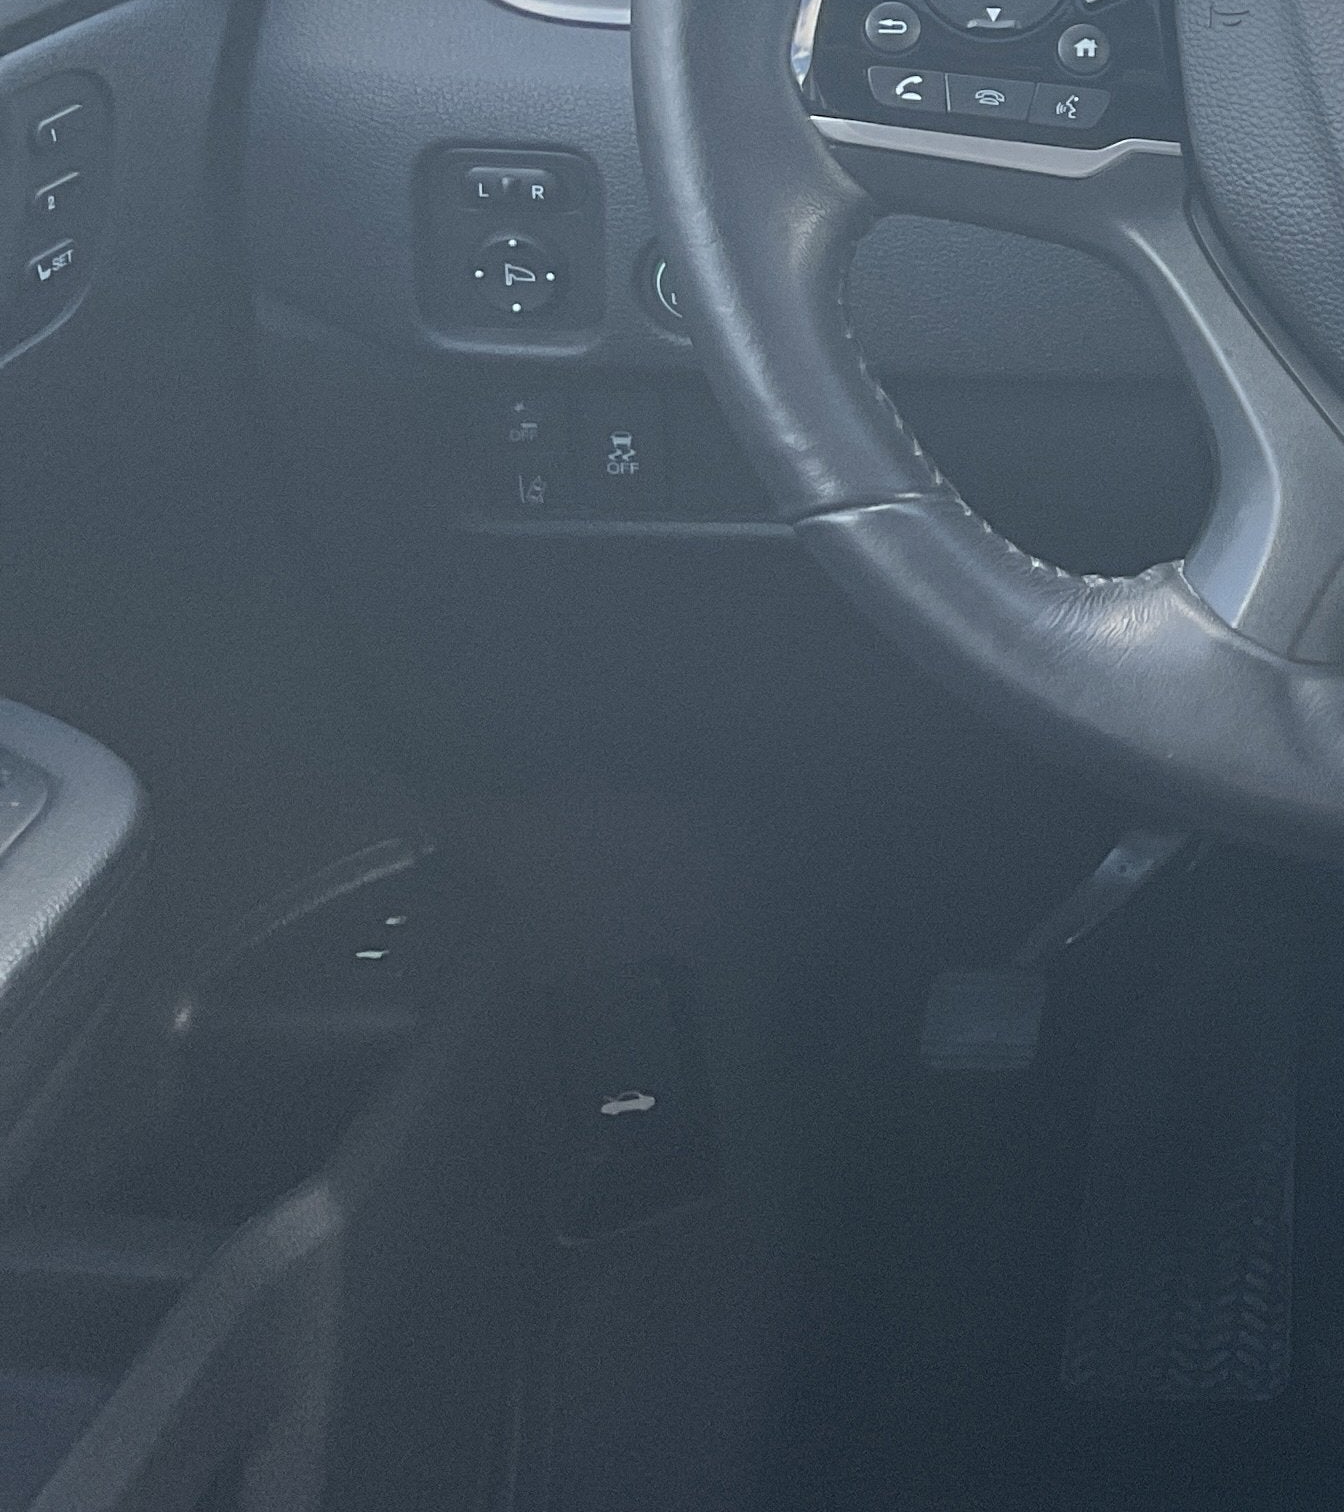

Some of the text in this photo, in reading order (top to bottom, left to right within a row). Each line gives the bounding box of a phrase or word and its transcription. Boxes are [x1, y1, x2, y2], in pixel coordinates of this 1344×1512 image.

[479, 183, 488, 197] L
[532, 185, 543, 199] R
[48, 196, 55, 209] 2
[51, 249, 74, 271] SET
[607, 462, 638, 474] OFF
